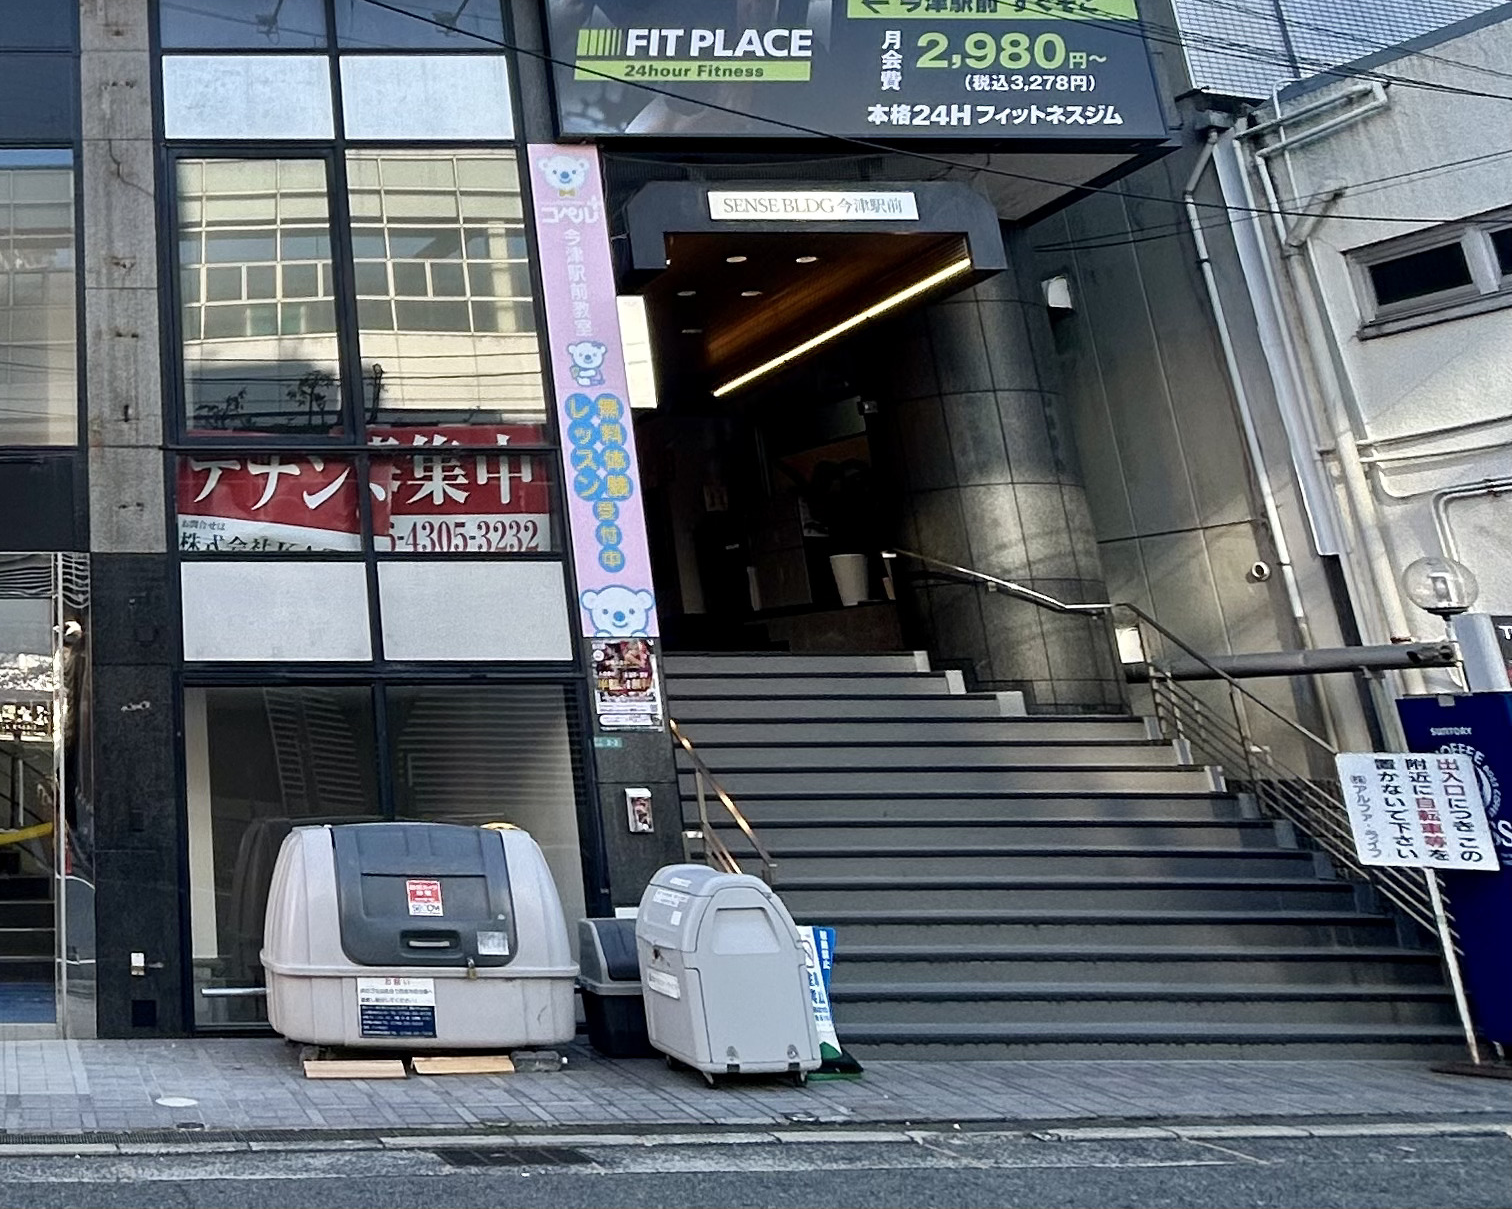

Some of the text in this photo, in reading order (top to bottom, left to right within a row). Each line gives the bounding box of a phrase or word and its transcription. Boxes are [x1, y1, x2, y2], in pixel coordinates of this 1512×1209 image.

[626, 29, 813, 57] FIT PLACE
[624, 63, 764, 79] 24hour Fitness
[881, 30, 903, 91] 月会費
[724, 197, 903, 214] SENSE BLDG 今津駅前
[564, 228, 594, 337] 今津駅前教室
[569, 397, 601, 497] レッスン
[1435, 743, 1486, 765] OFFEE
